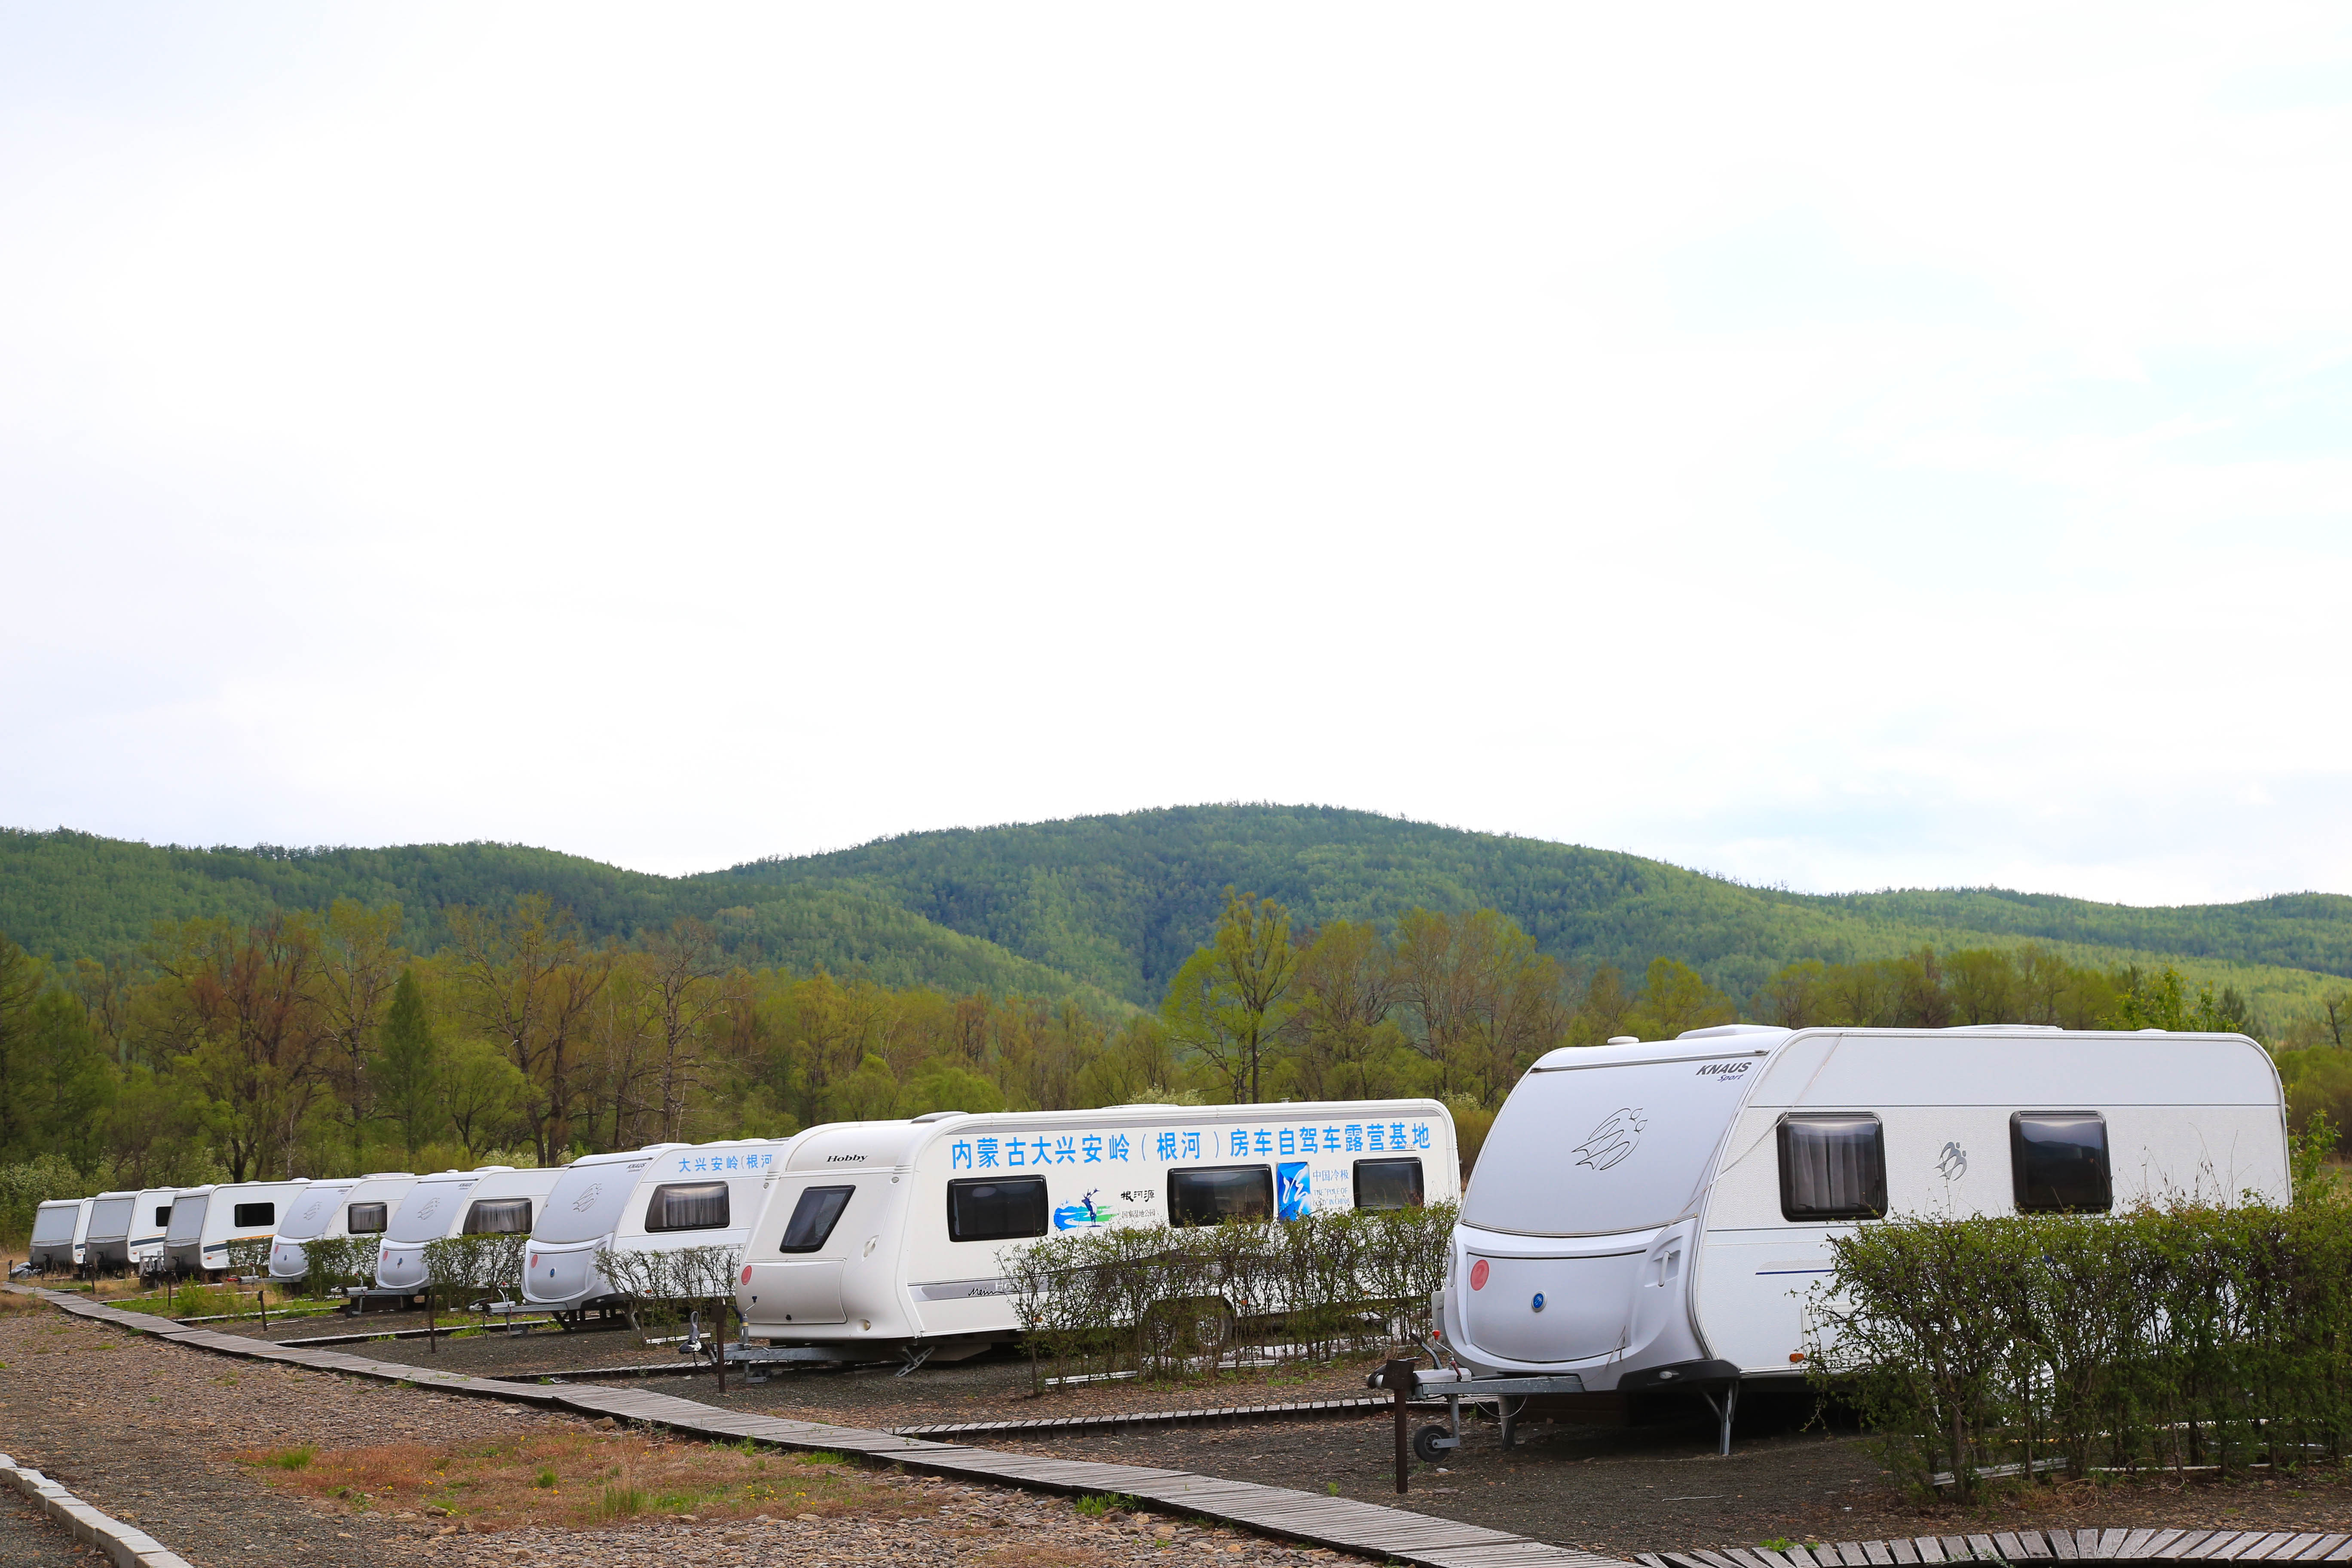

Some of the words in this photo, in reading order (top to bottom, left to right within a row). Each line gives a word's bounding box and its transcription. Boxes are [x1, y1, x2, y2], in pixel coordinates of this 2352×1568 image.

[1695, 1062, 1752, 1075] KNAUS
[1717, 1074, 1744, 1082] Sport
[952, 1122, 1430, 1170] 内蒙古大兴安岭（根河）房车自驾车露营基地
[1313, 1169, 1349, 1182] 中国冷极
[1121, 1190, 1155, 1202] 根河源
[1122, 1209, 1155, 1219] 国家湿地公园
